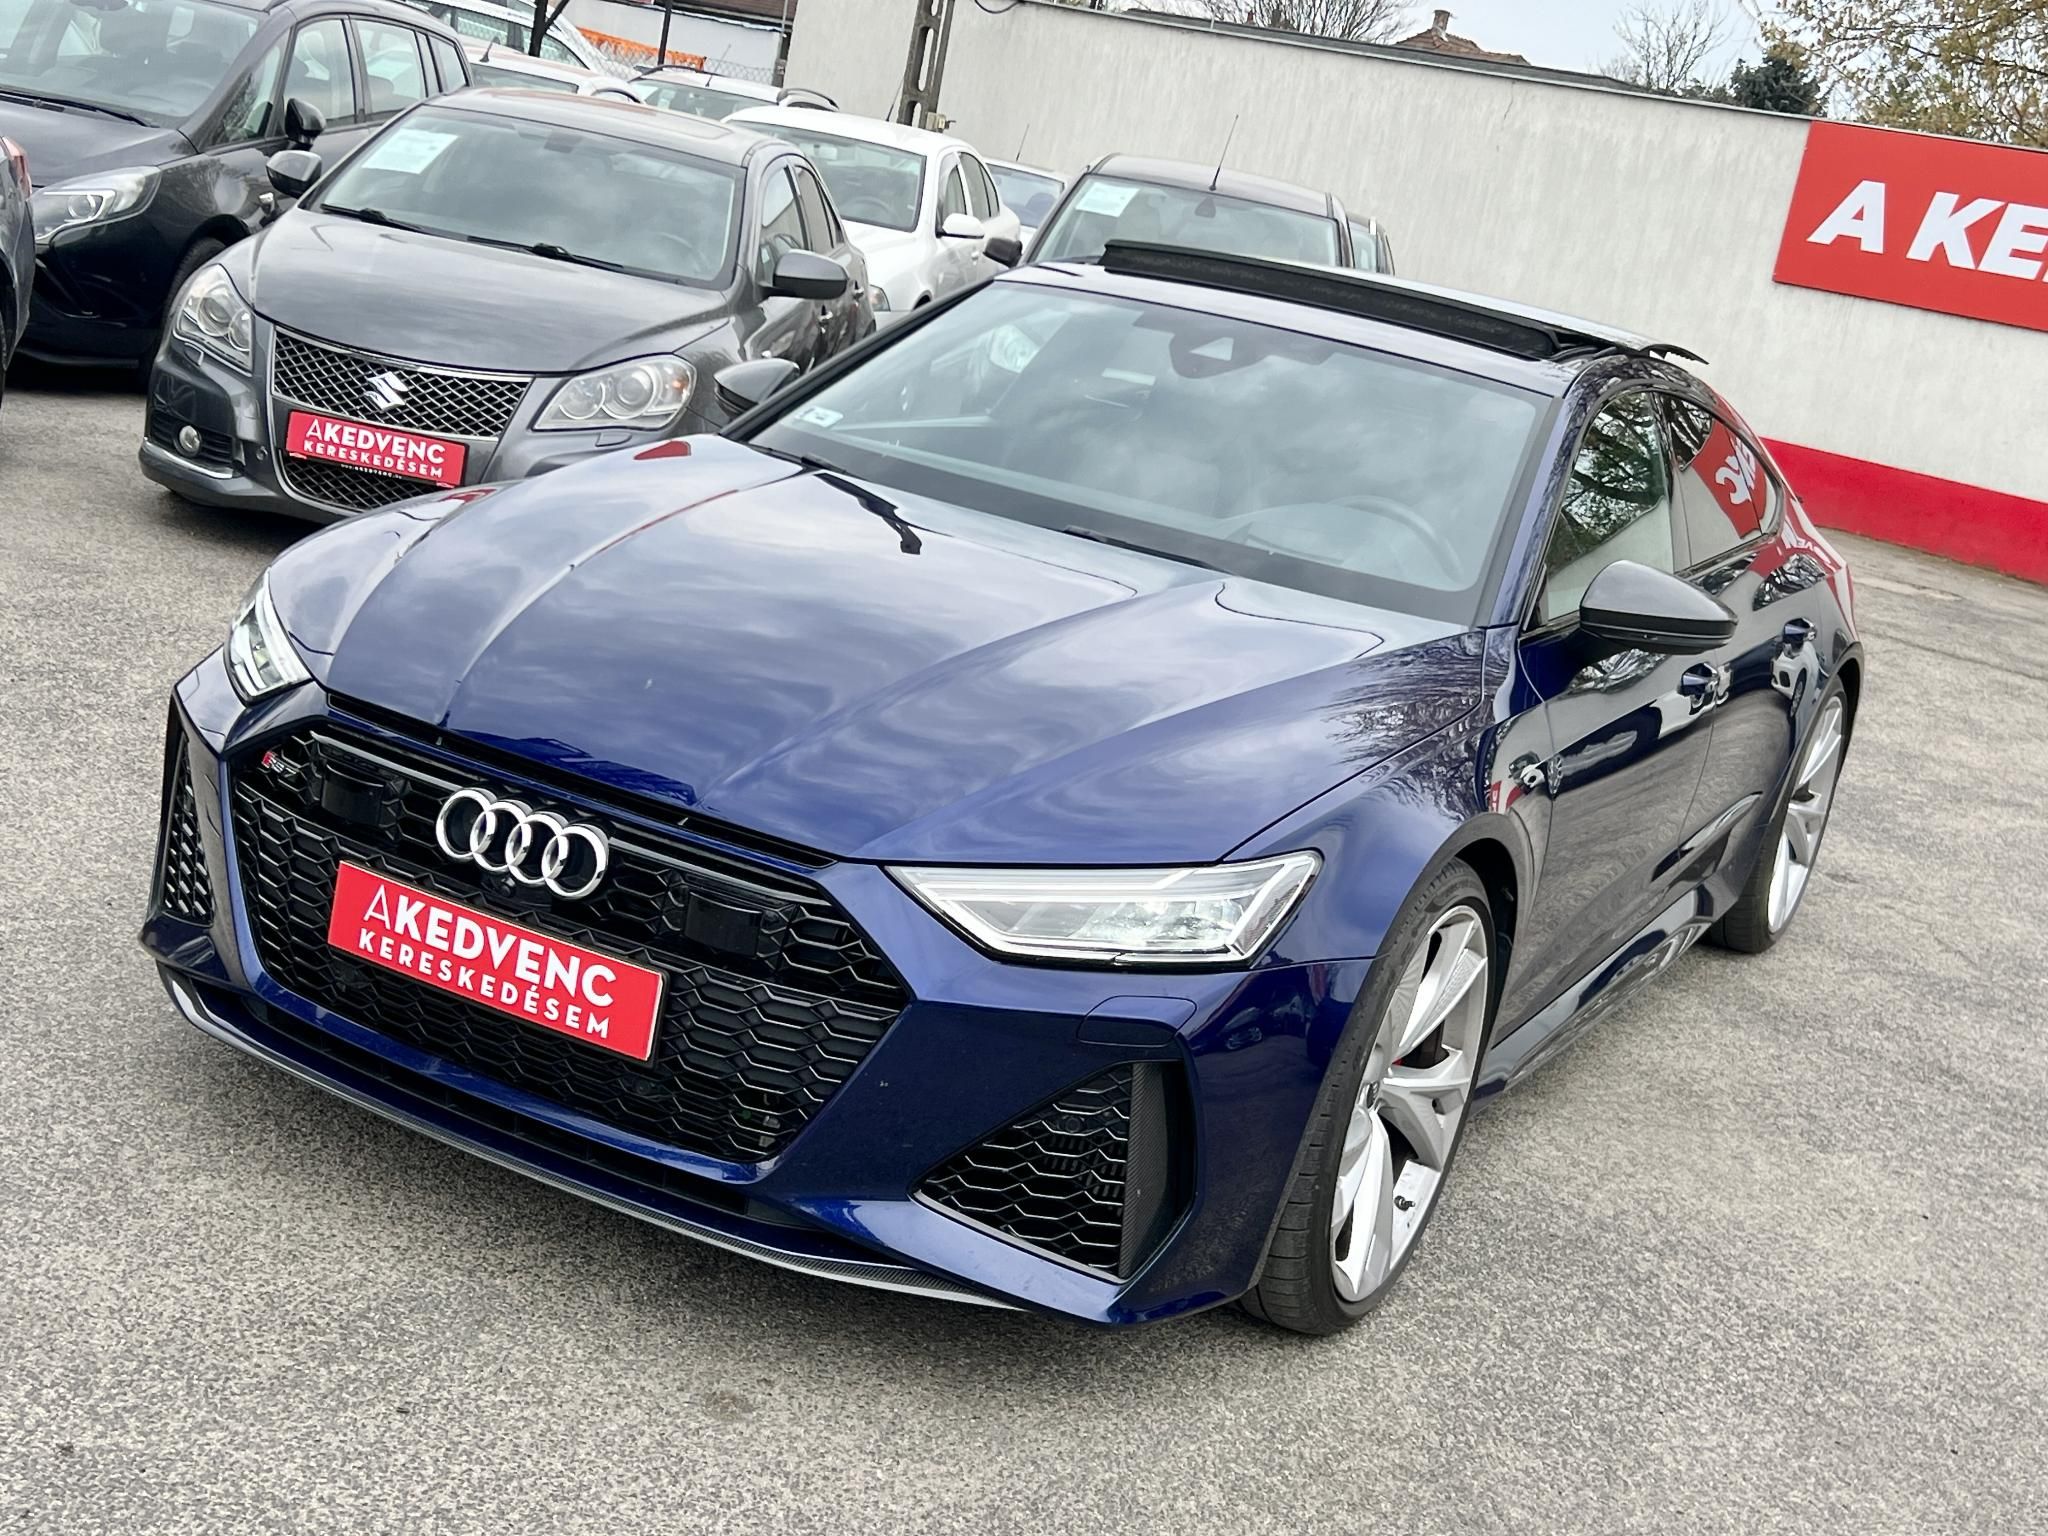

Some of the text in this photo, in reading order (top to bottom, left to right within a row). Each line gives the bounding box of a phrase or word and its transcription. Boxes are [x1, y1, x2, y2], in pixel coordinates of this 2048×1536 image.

[1805, 179, 2048, 284] A KE
[303, 439, 443, 479] KERESKEDÉSEM
[358, 927, 610, 1039] KERESKEDÉSEM
